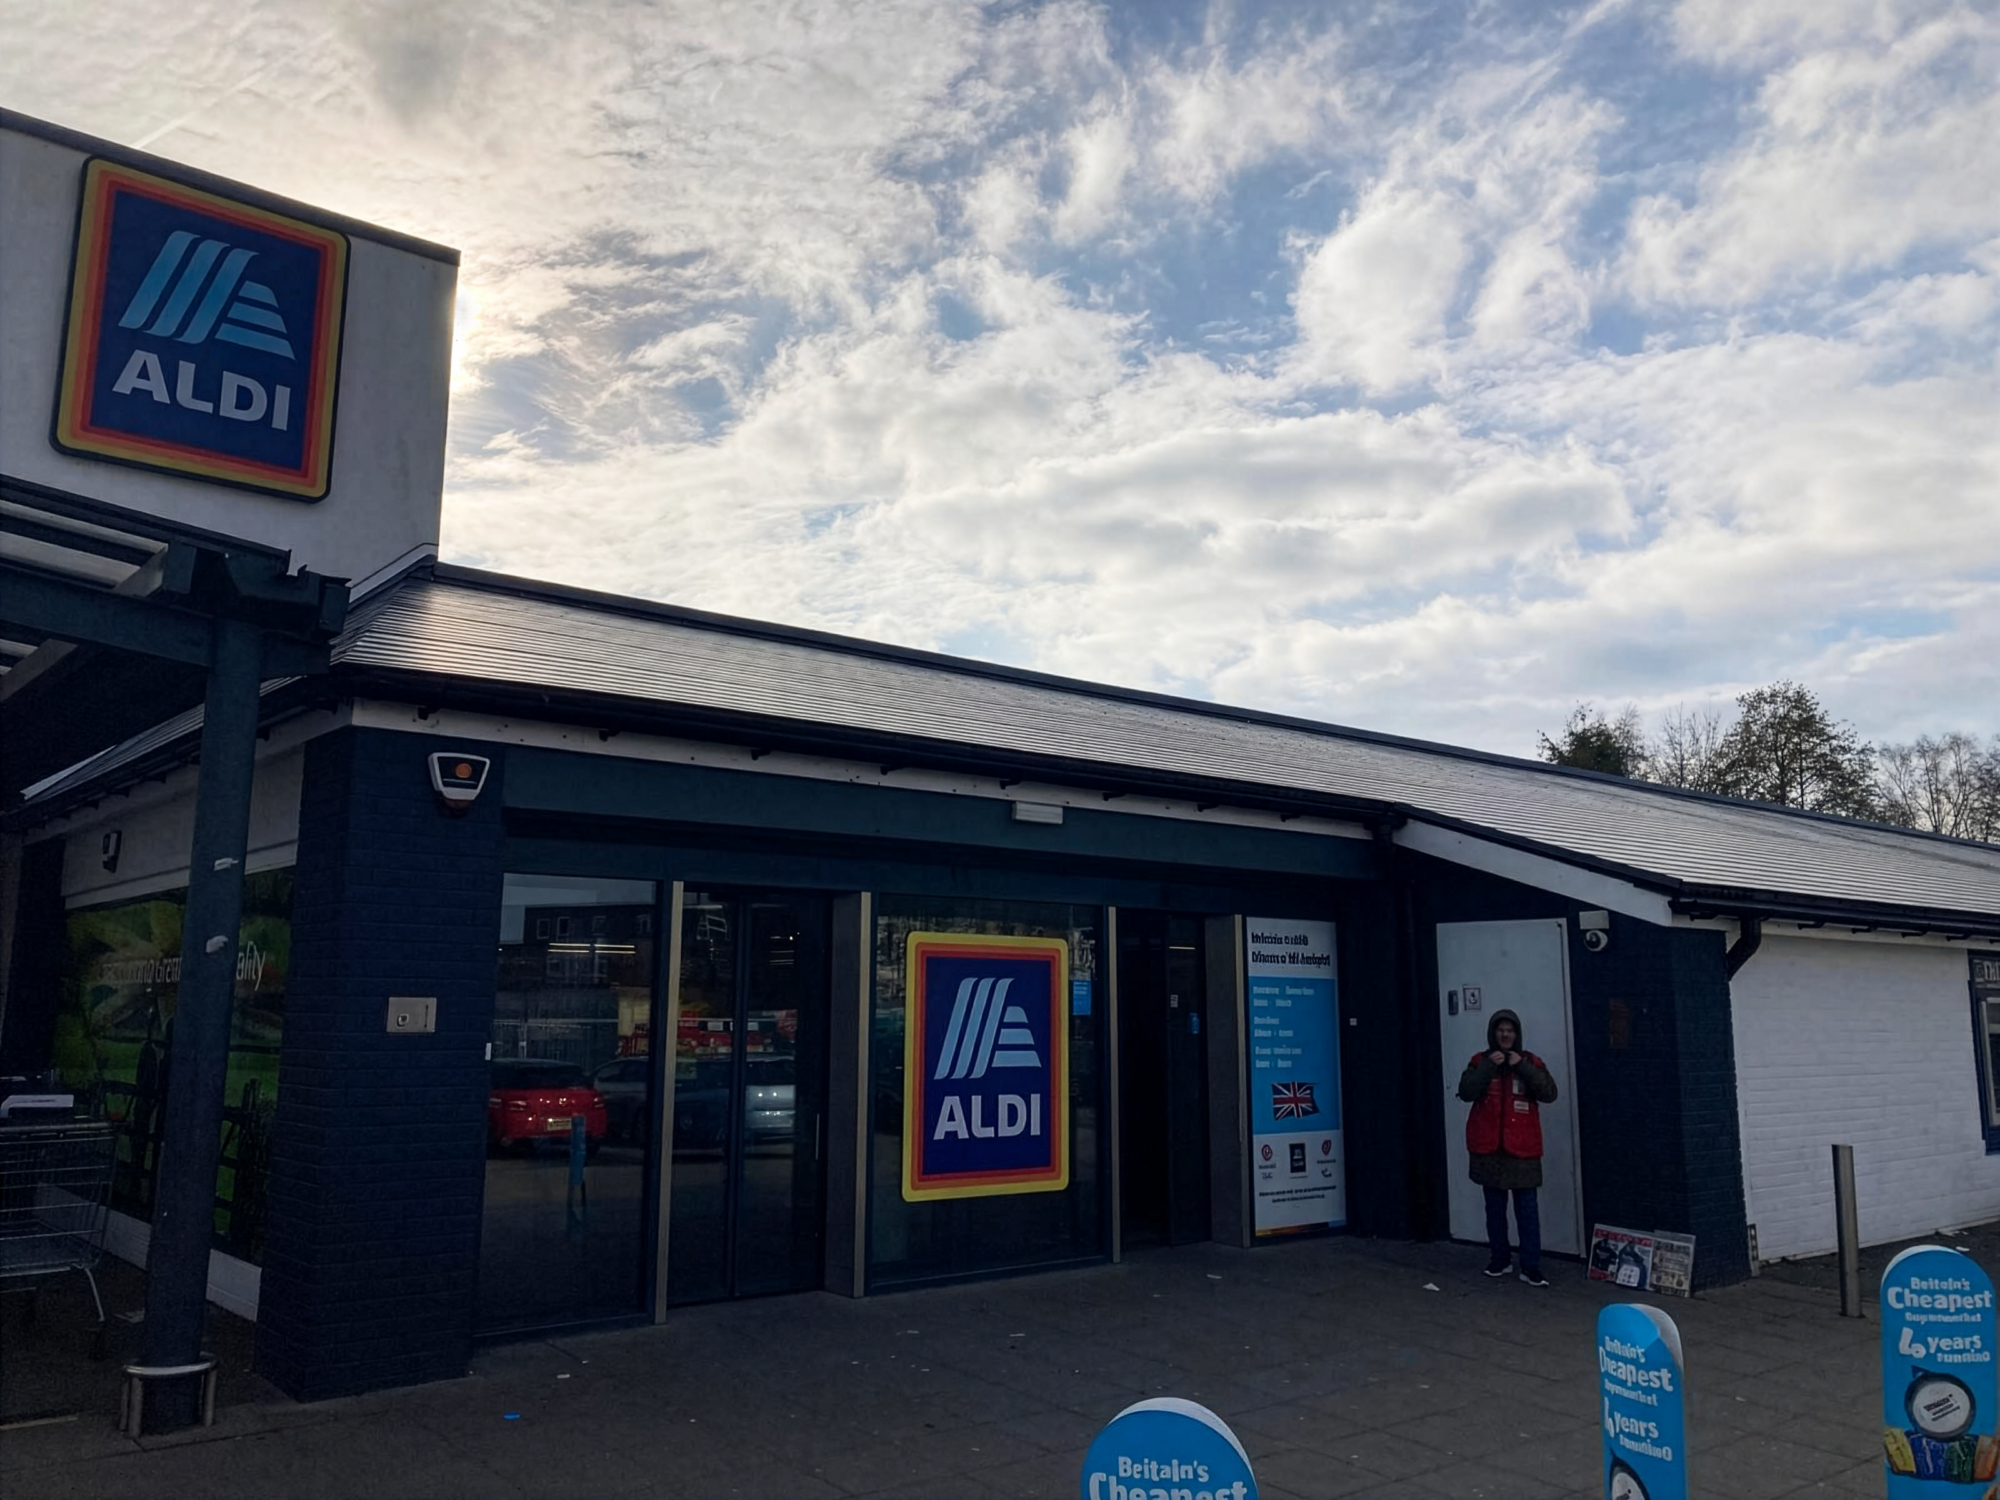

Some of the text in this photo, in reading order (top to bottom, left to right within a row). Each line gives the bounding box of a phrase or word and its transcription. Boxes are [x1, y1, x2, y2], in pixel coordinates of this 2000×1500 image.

[112, 349, 292, 431] ALDI
[933, 1094, 1041, 1140] ALDI
[1887, 1287, 1992, 1312] Cheapest
[1927, 1335, 1982, 1354] years
